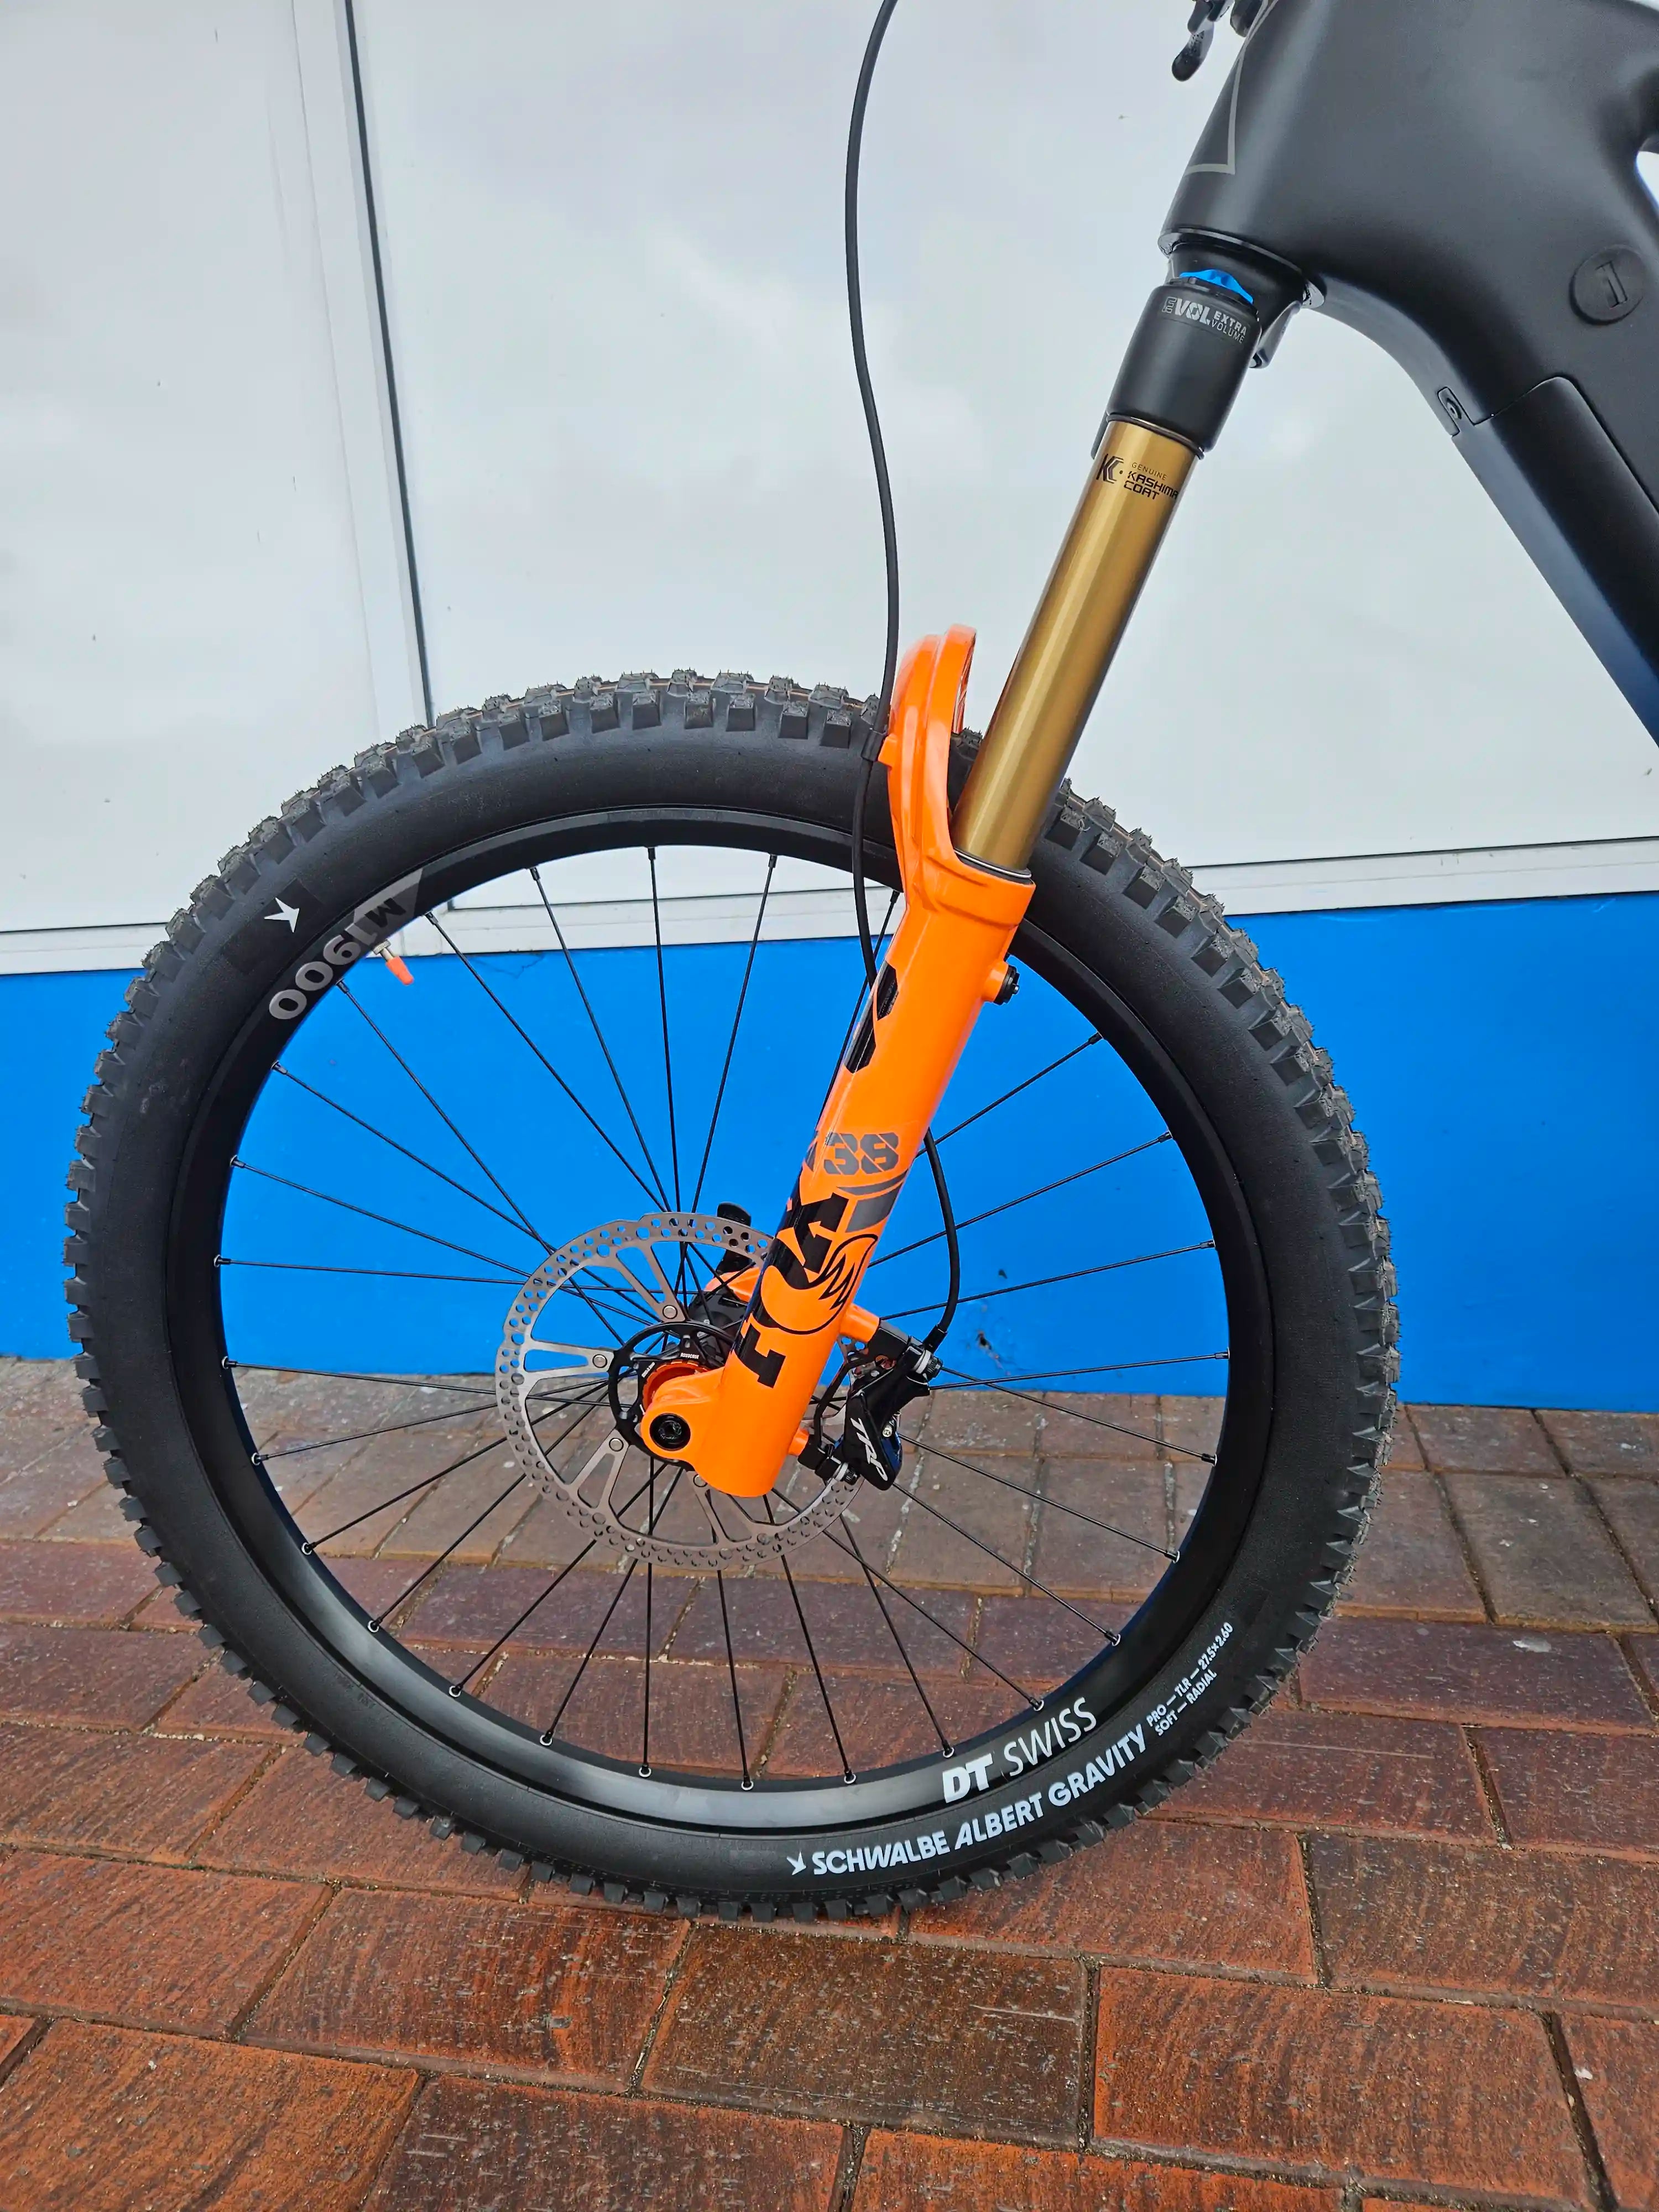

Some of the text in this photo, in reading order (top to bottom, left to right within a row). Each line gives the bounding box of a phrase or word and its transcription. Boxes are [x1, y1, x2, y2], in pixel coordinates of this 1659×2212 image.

[1162, 296, 1211, 326] EVOL
[1212, 319, 1245, 344] VOLUME
[1213, 310, 1247, 336] EXTRA
[1123, 480, 1160, 500] COAT
[1127, 471, 1180, 500] KASHIMA
[1131, 462, 1168, 481] GENUINE
[269, 896, 406, 1020] M1900
[823, 1131, 900, 1175] 38
[850, 1417, 888, 1481] TRP
[1146, 1703, 1167, 1727] PRO
[1174, 1677, 1192, 1697] TLR
[1155, 1709, 1178, 1736] SOFT
[1186, 1668, 1217, 1704] RADIAL
[942, 1697, 1097, 1803] DT SWISS
[812, 1723, 1147, 1876] SCHWALBE ALBERT GRAVITY
